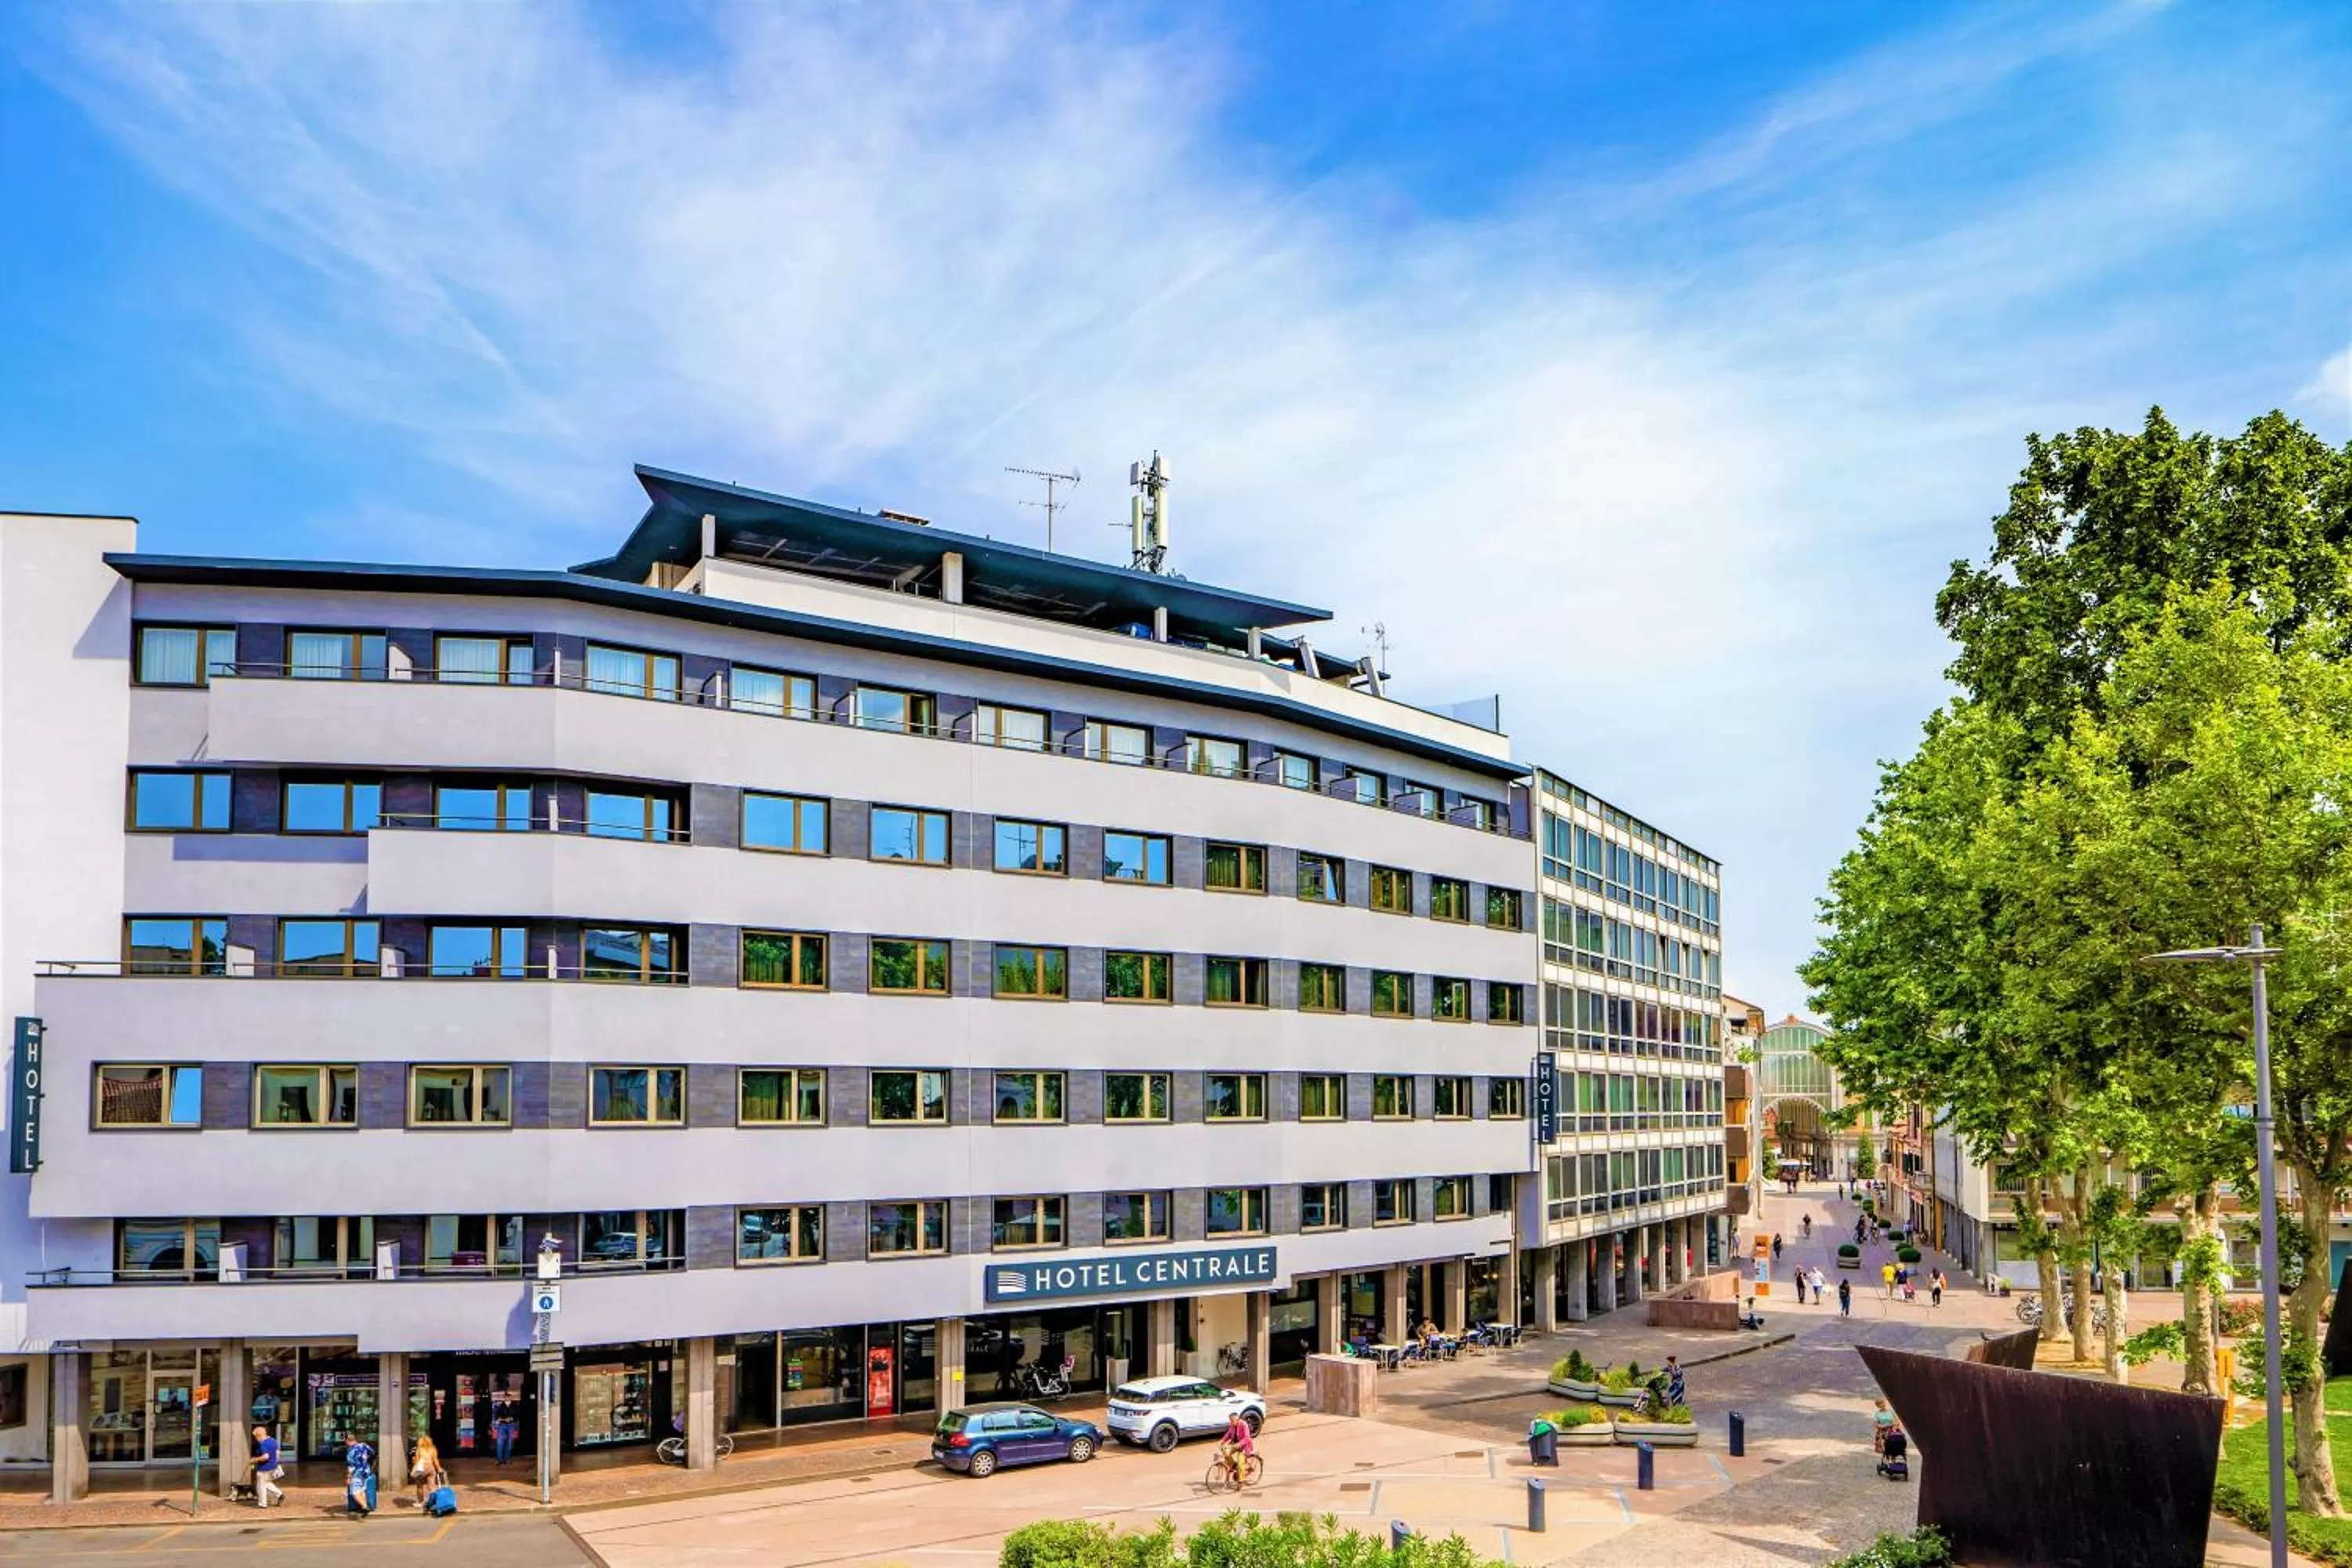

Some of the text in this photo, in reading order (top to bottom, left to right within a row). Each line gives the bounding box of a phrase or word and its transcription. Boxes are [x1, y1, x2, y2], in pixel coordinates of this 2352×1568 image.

[24, 1042, 38, 1169] HOTEL
[1539, 1067, 1551, 1142] HOTEL
[1036, 1254, 1269, 1290] HOTEL CENTRALE
